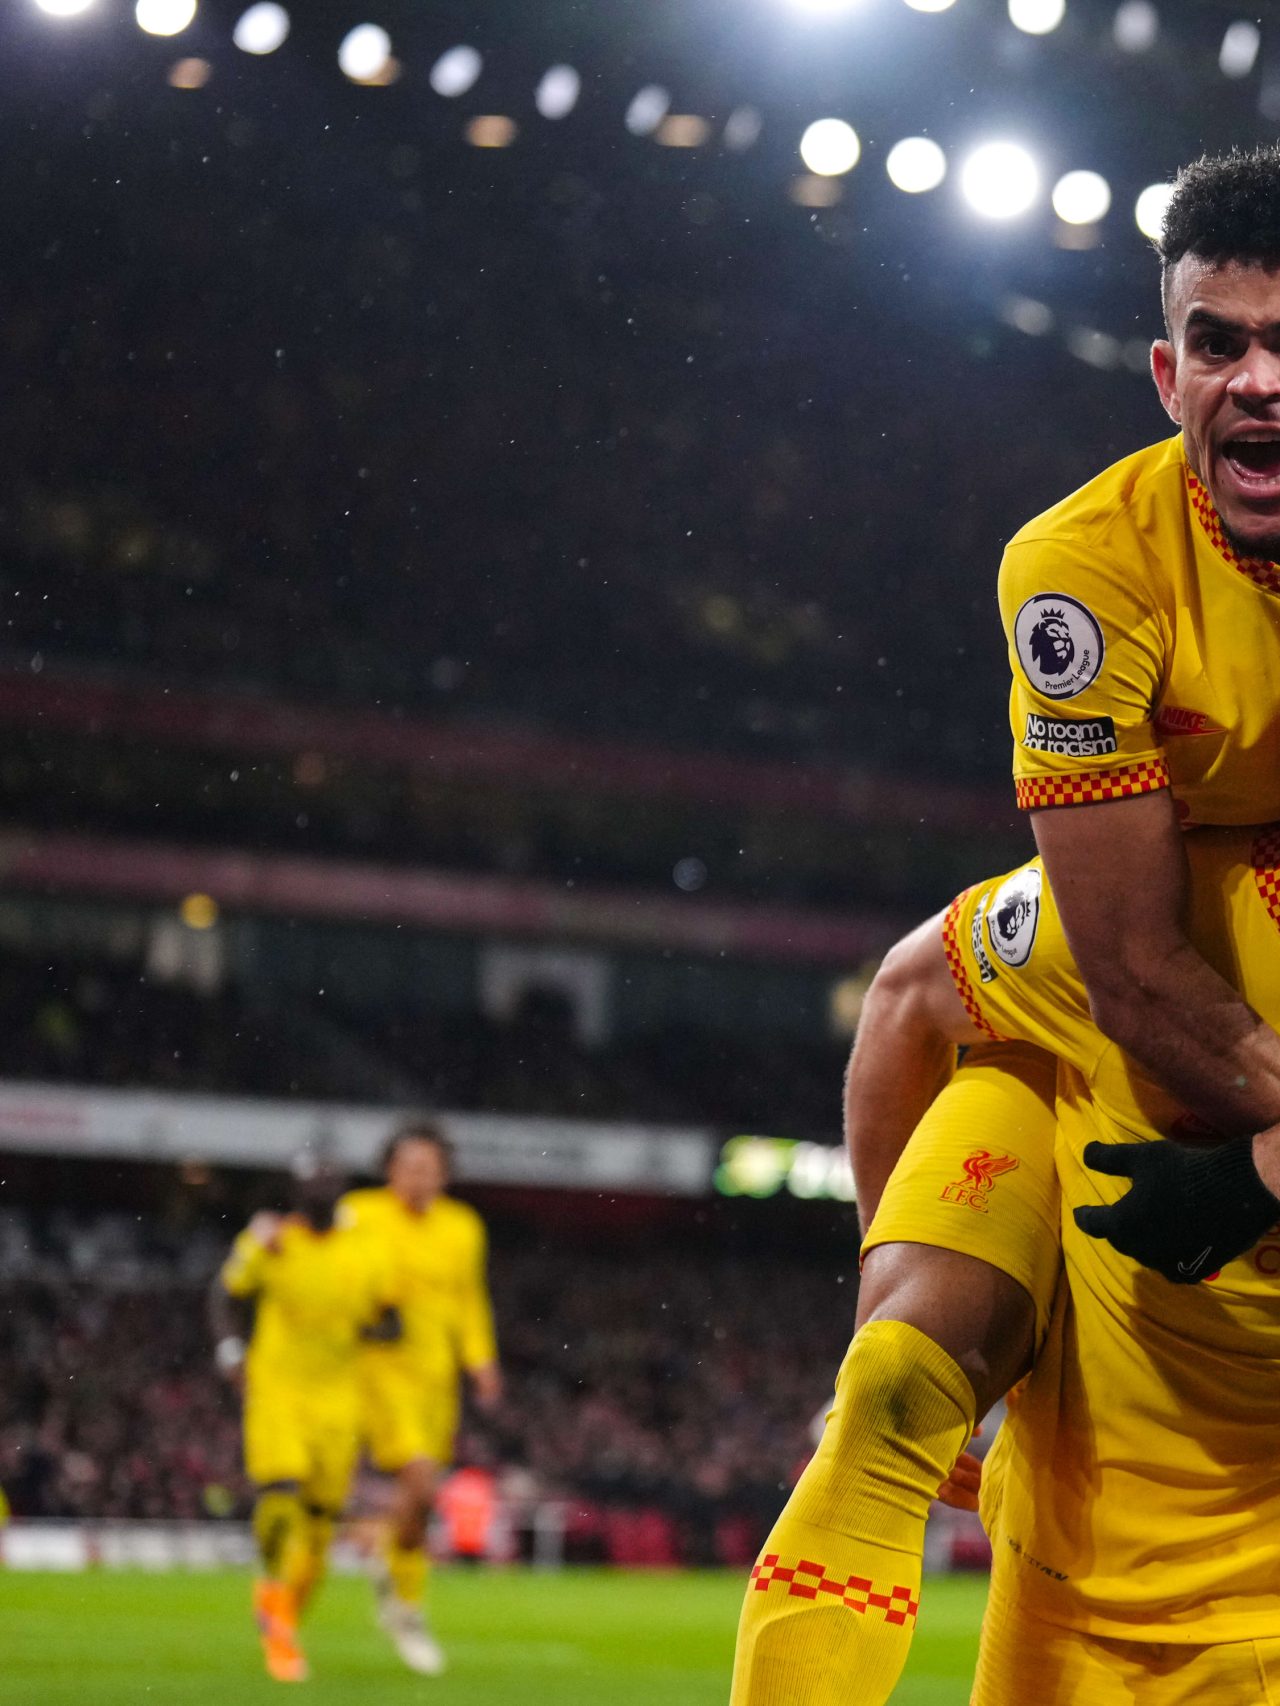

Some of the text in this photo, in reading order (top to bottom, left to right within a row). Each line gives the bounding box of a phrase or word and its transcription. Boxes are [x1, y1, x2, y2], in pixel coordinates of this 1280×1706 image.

[1045, 649, 1090, 690] Premier League
[1025, 715, 1103, 738] No room
[1022, 735, 1116, 757] for racism
